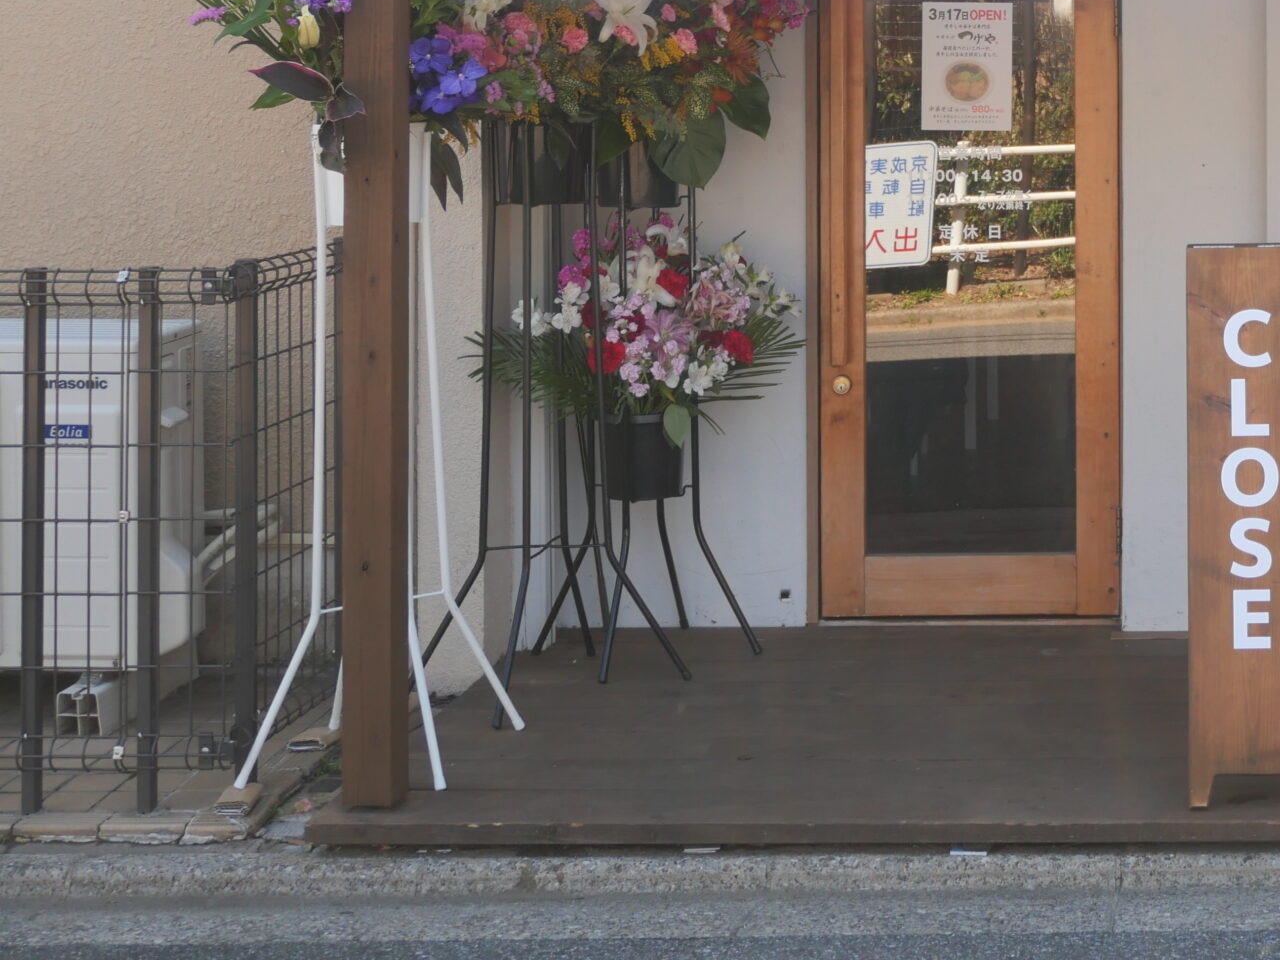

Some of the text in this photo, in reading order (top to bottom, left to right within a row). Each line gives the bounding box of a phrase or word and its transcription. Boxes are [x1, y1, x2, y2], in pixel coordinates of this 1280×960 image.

[958, 31, 997, 44] つげや
[972, 105, 990, 113] 980
[44, 377, 108, 390] nasonic
[49, 426, 83, 438] Eolia
[1220, 309, 1280, 649] CLOSE
